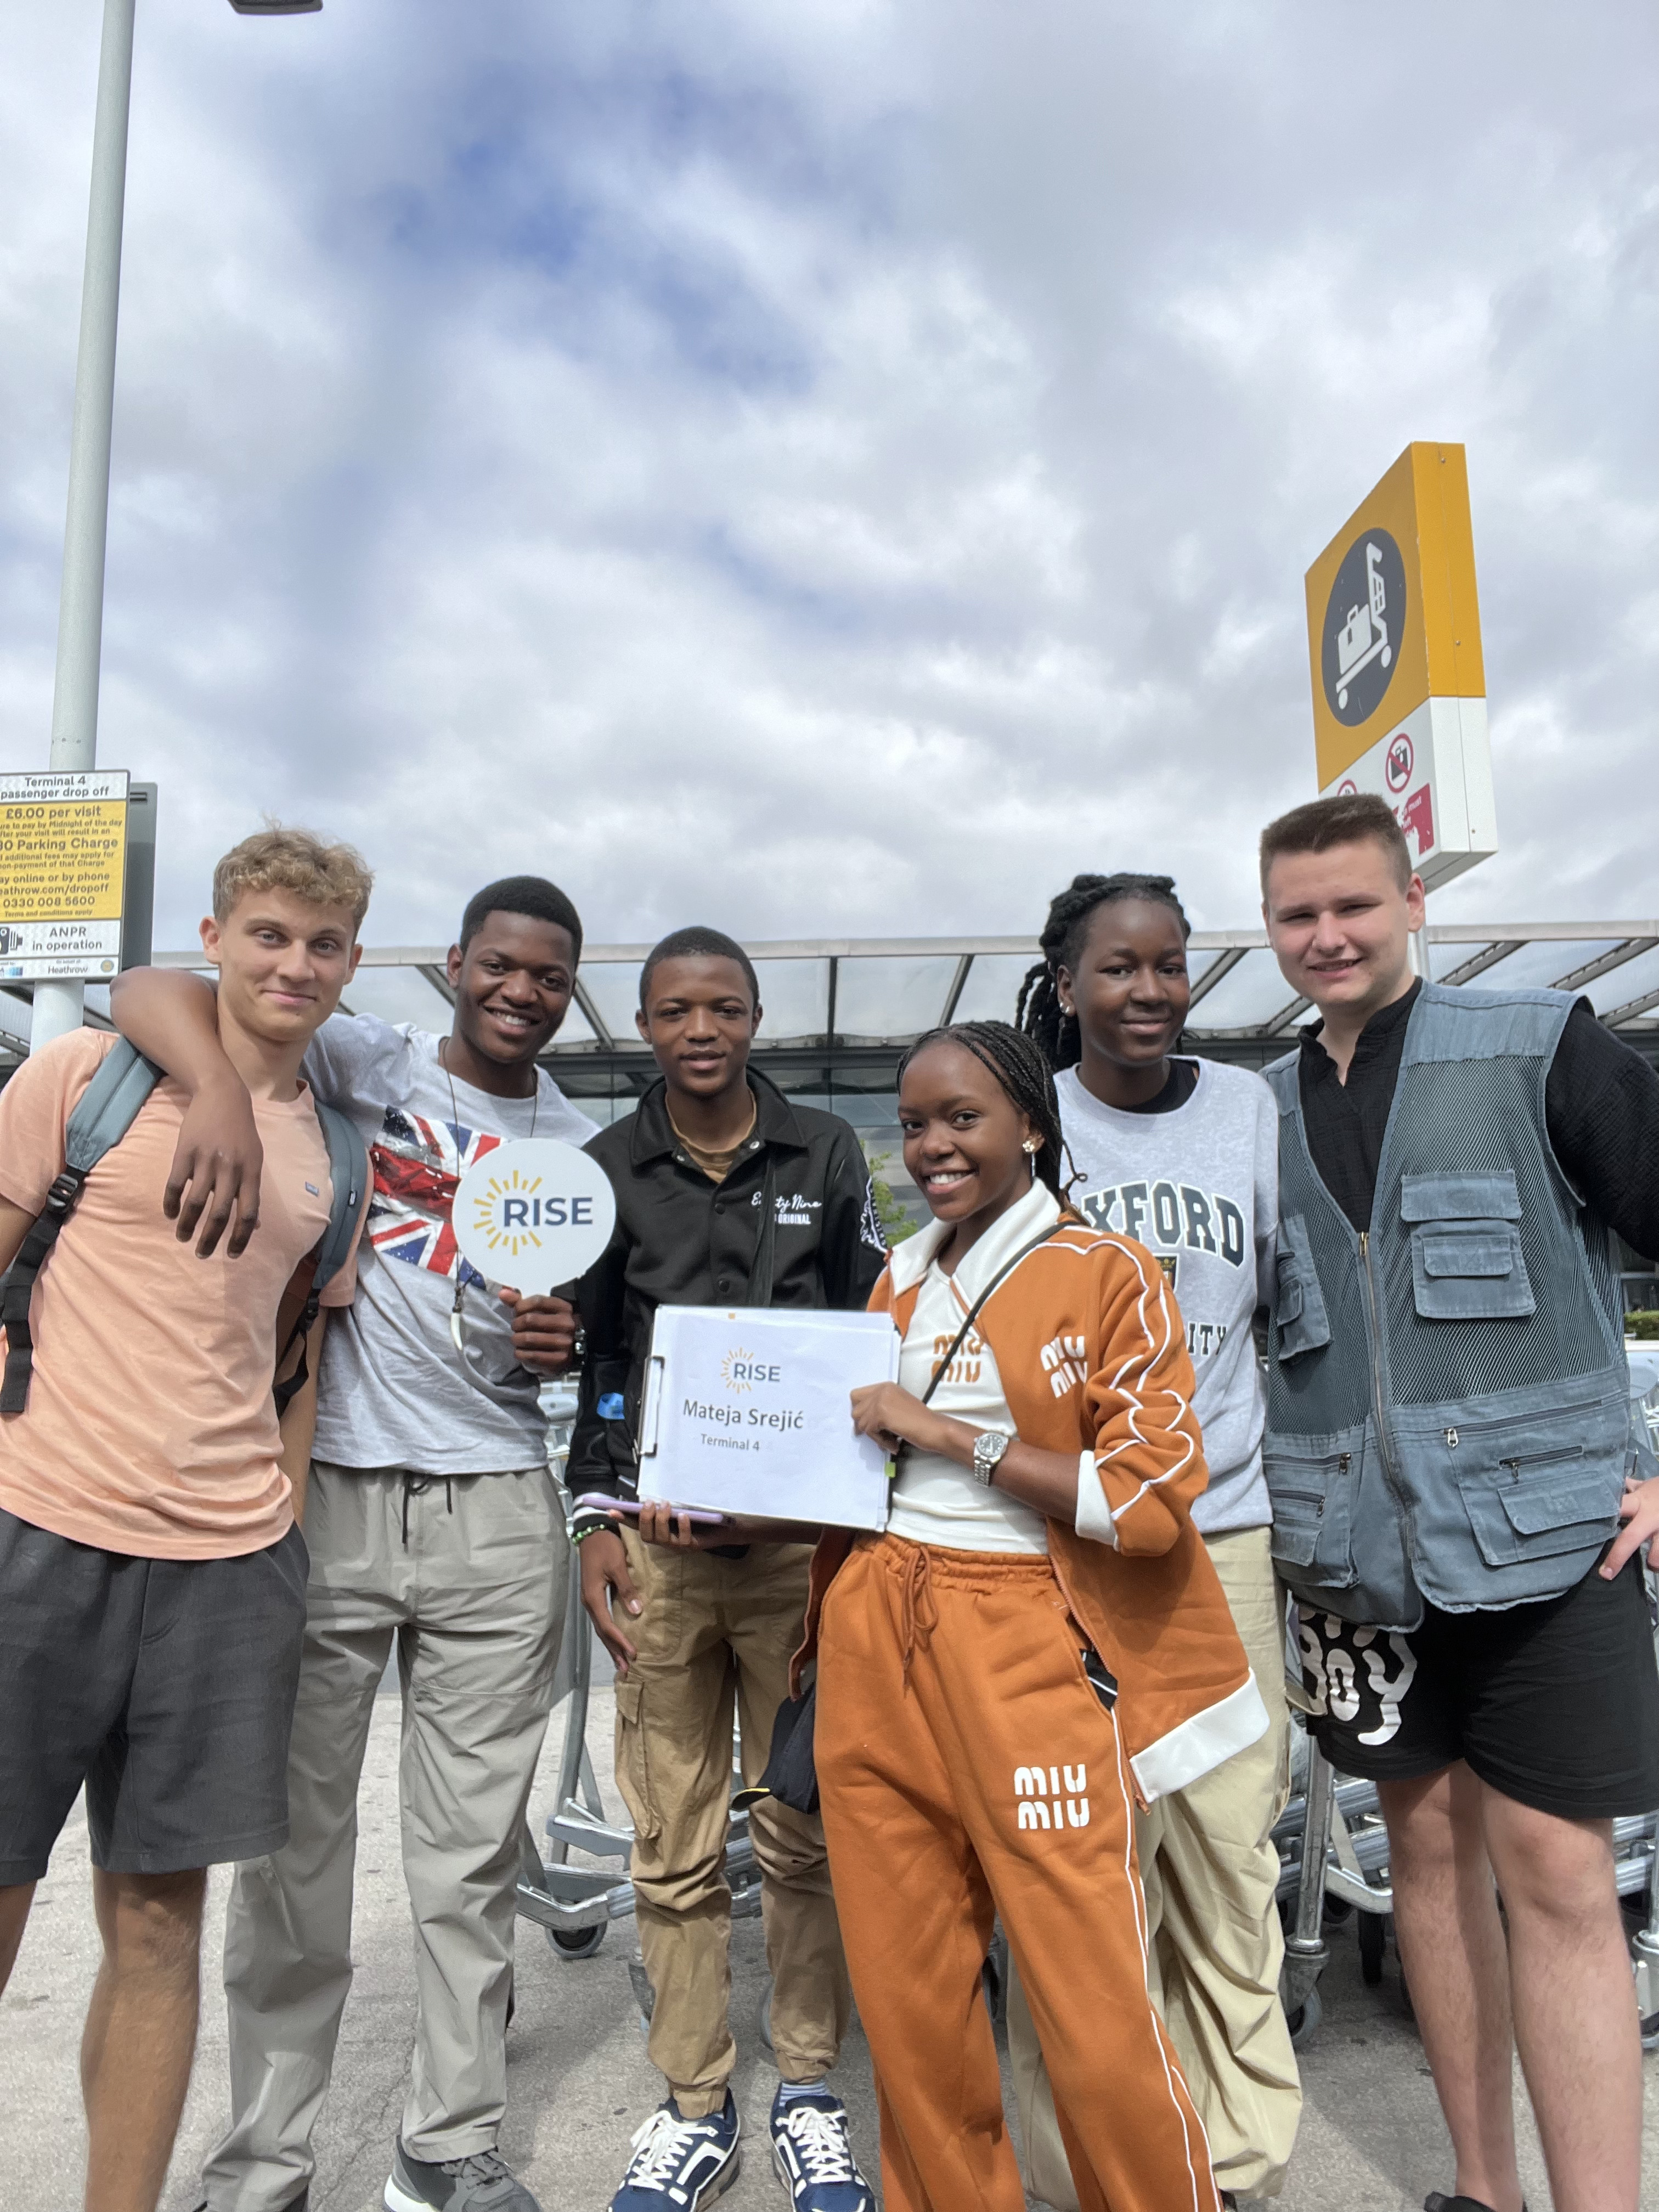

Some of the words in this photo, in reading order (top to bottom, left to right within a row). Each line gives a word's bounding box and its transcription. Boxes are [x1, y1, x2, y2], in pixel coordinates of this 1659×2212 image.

[25, 775, 74, 787] Terminal
[77, 775, 86, 786] 4
[1, 789, 59, 800] passenger
[63, 787, 89, 798] drop
[93, 786, 109, 796] off
[6, 807, 44, 820] £6.00
[49, 809, 70, 820] per
[75, 805, 101, 817] visit
[49, 820, 82, 828] Midnight
[109, 819, 122, 827] day
[17, 839, 66, 851] Parking
[71, 837, 118, 850] Charge
[5, 853, 42, 861] additional
[81, 851, 101, 860] apply
[77, 859, 105, 867] Charge
[13, 873, 44, 883] online
[63, 872, 74, 883] by
[78, 872, 110, 882] phone
[3, 898, 34, 909] 0330
[38, 897, 61, 907] 008
[65, 896, 95, 906] 5600
[49, 926, 87, 938] ANPR
[32, 940, 42, 951] in
[47, 939, 102, 951] operation
[48, 966, 88, 974] Heathrow
[504, 1197, 593, 1227] RISE
[778, 1214, 811, 1224] ORIGINAL
[1081, 1179, 1245, 1270] XFORD
[733, 1362, 781, 1382] RISE
[684, 1399, 742, 1426] Mateja
[748, 1408, 804, 1431] Srejić
[701, 1433, 749, 1450] Terminal
[752, 1440, 760, 1451] 4
